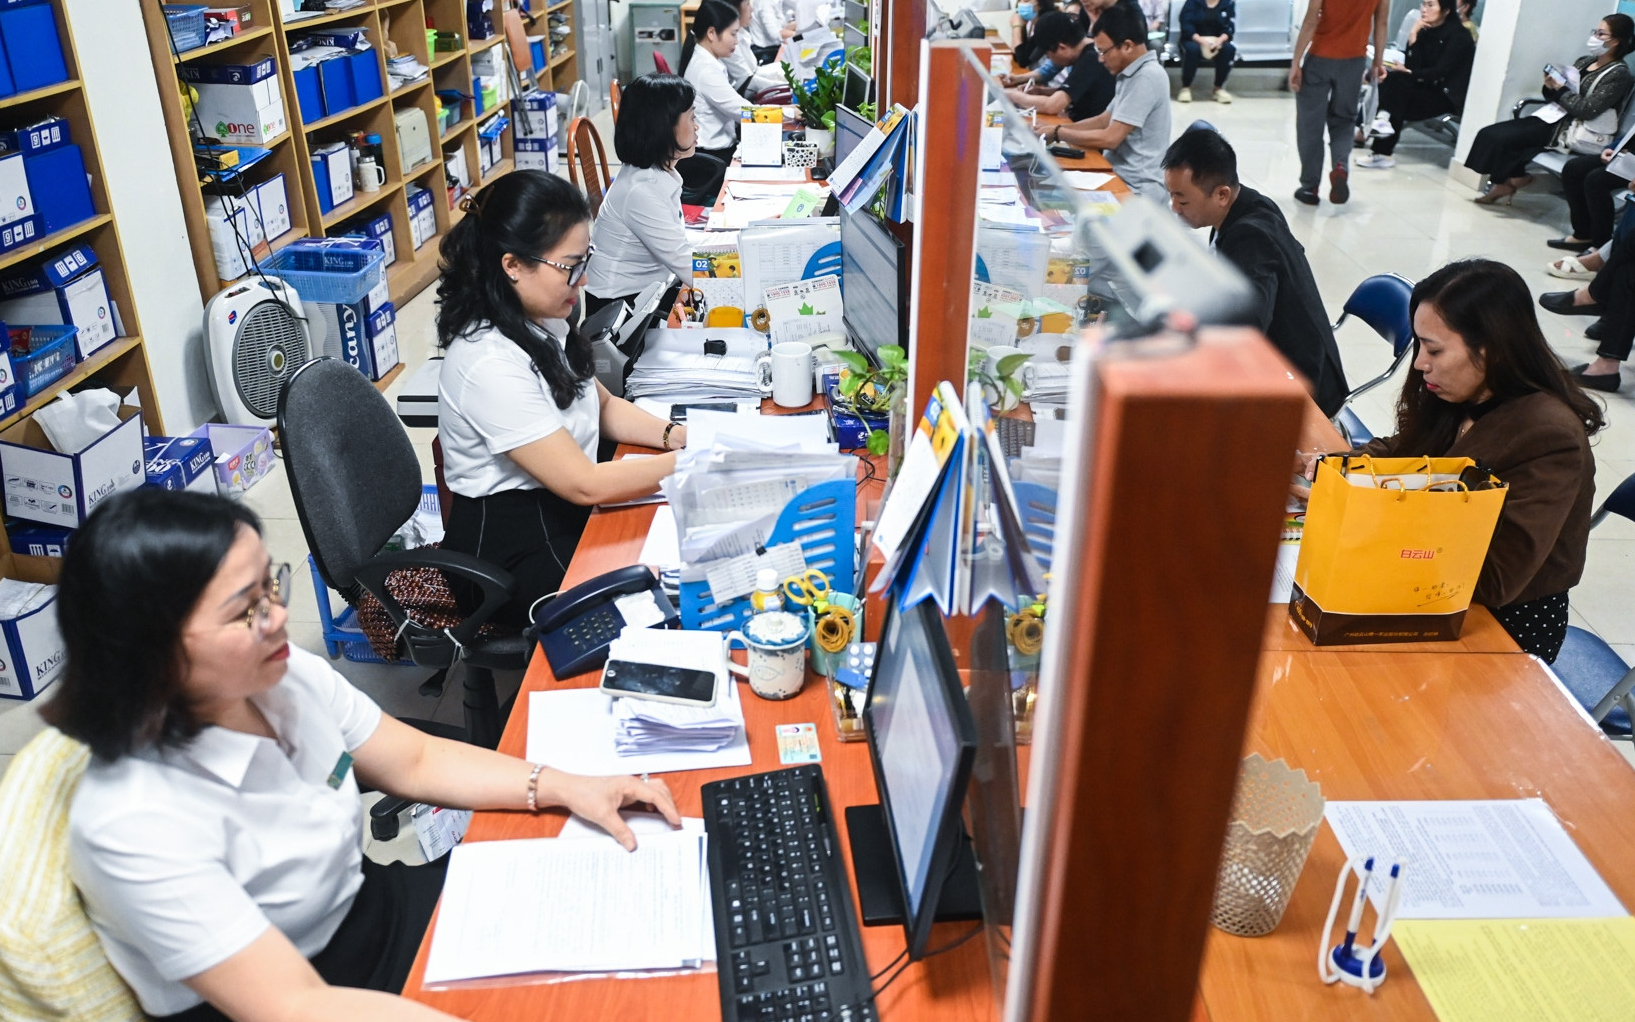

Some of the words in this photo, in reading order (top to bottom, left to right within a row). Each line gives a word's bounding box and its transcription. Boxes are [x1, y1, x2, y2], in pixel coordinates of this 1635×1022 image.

[695, 260, 708, 268] 02
[1400, 549, 1435, 560] 白云山
